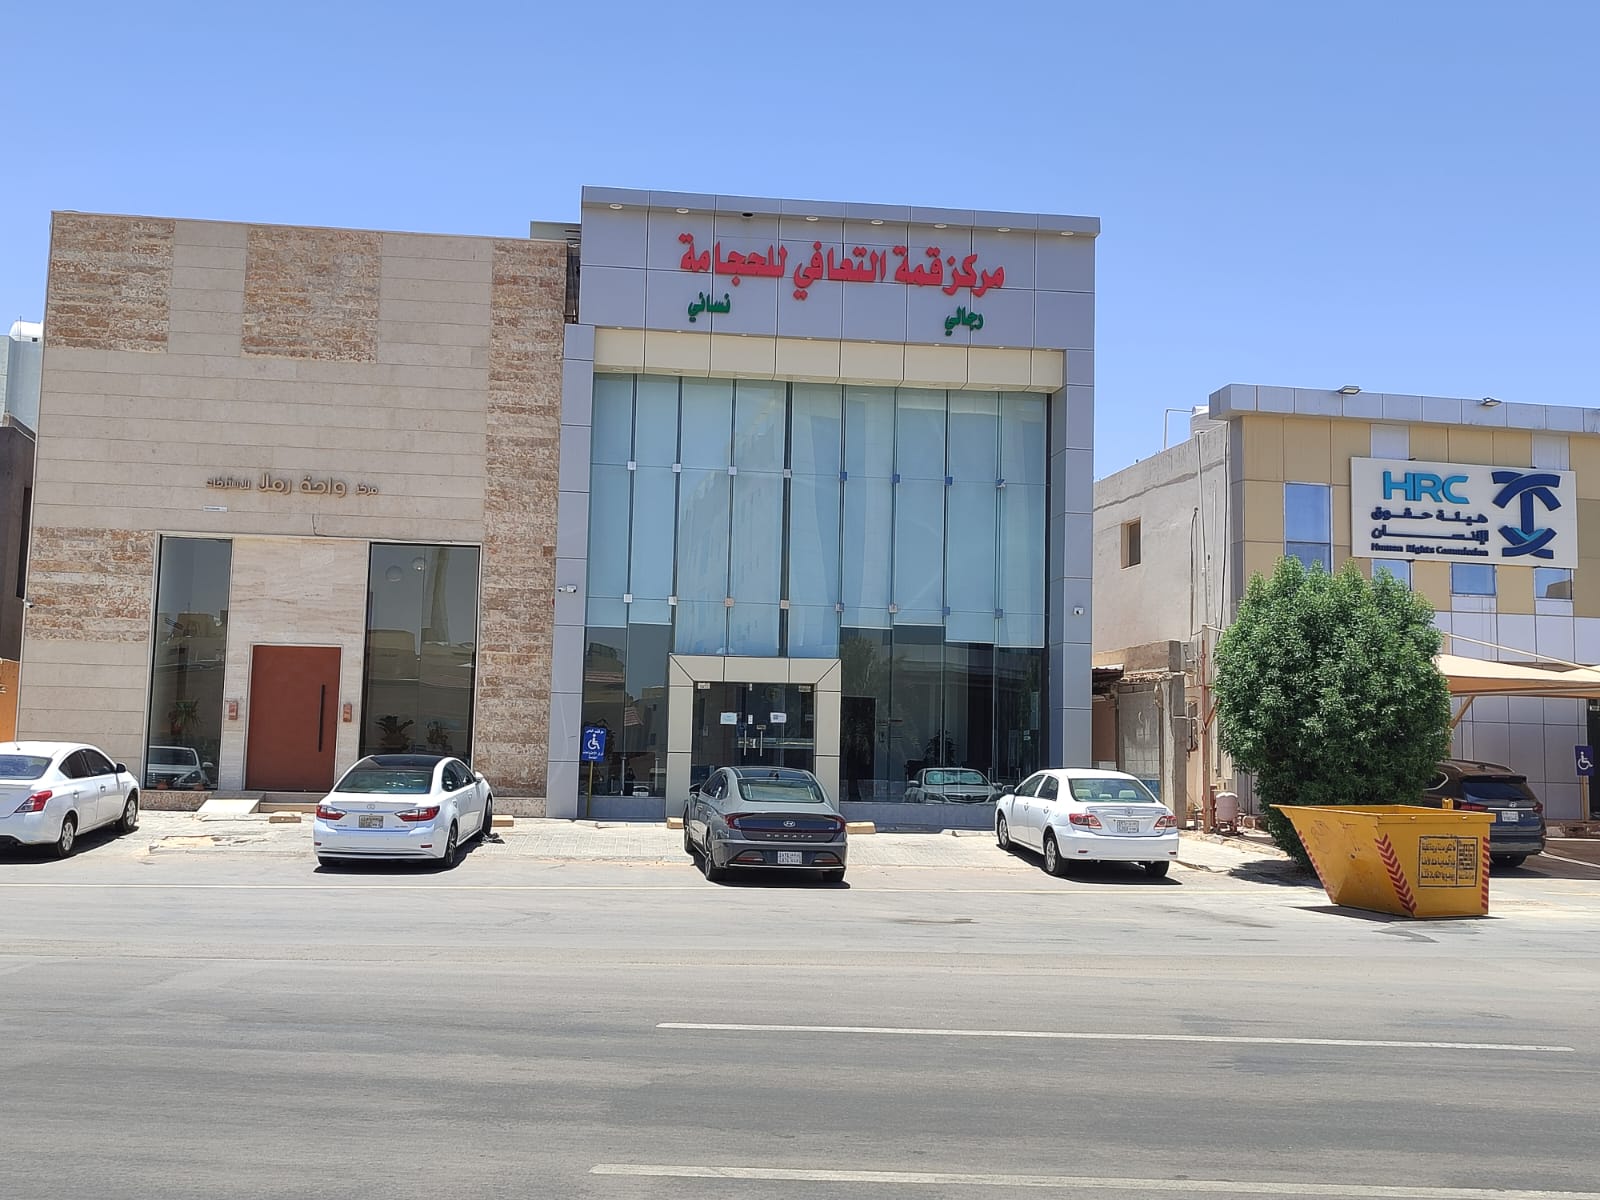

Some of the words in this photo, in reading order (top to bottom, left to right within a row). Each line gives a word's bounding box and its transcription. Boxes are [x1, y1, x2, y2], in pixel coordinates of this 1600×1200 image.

[678, 232, 788, 287] للحجامة
[793, 241, 887, 300] التعافي
[893, 244, 944, 287] قمة
[942, 252, 1005, 297] مركز
[687, 291, 731, 323] نسائي
[944, 305, 984, 336] رجالي
[257, 472, 292, 496] رمل
[300, 474, 347, 499] واحة
[1382, 470, 1470, 504] HRC
[1371, 506, 1433, 521] حقوق
